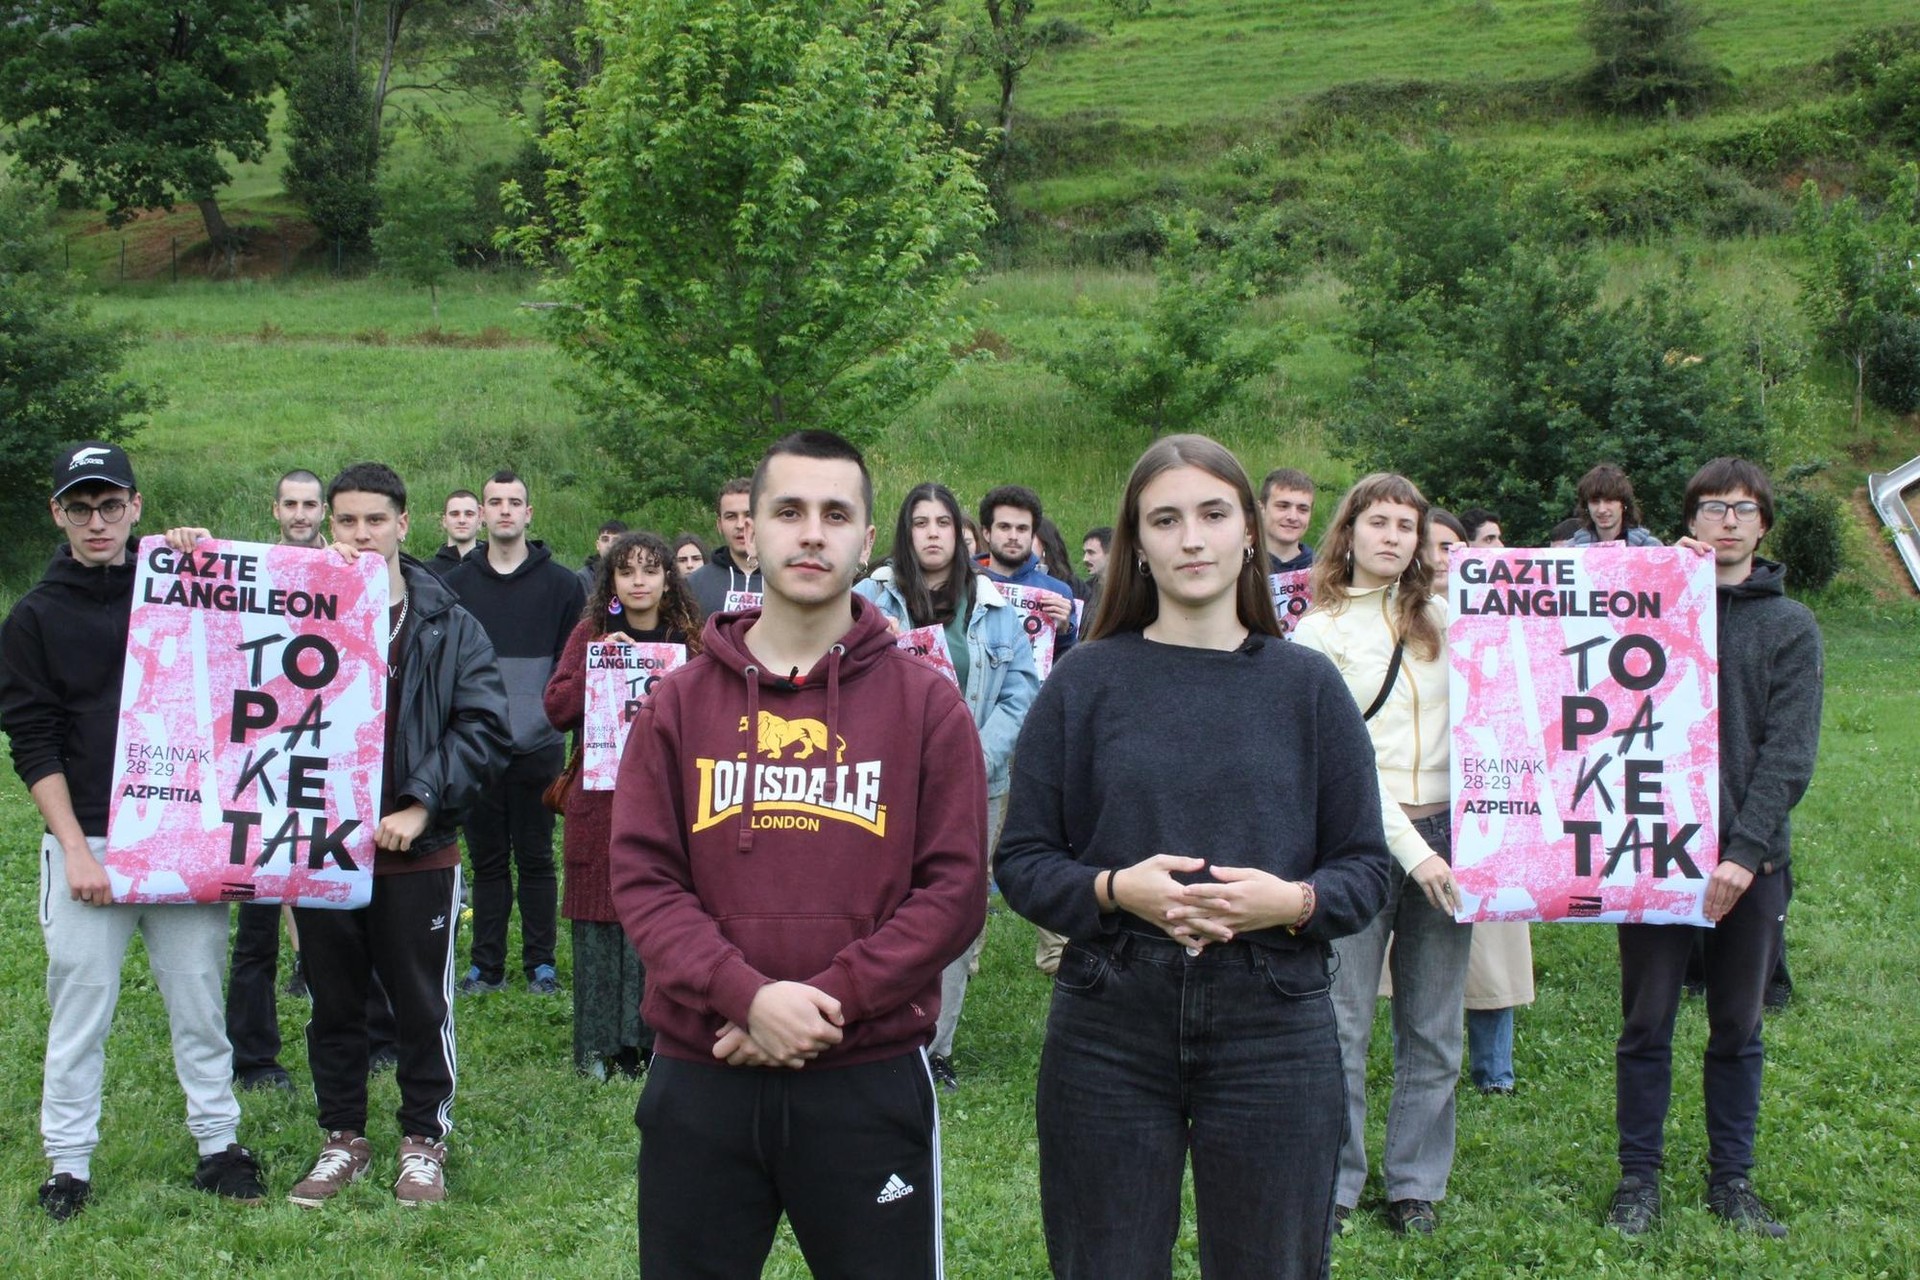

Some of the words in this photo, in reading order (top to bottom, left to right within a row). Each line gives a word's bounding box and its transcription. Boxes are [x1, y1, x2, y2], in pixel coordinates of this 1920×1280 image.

[149, 547, 257, 581] GAZTE
[1460, 558, 1575, 585] GAZTE
[144, 577, 337, 620] LANGILEON
[1460, 589, 1660, 620] LANGILEON
[235, 633, 339, 690] TO
[589, 658, 665, 670] LANGILEON
[590, 645, 632, 657] GAZTE
[1559, 633, 1667, 693] TO
[230, 689, 332, 752] PA
[1561, 695, 1664, 757] PA
[126, 760, 175, 777] 28-29
[127, 743, 211, 765] EKAINAK
[1464, 758, 1544, 774] EKAINAK
[233, 748, 328, 810] KE
[1463, 775, 1511, 790] 28-29
[1568, 752, 1664, 816] KE
[123, 785, 203, 804] AZPEITIA
[1463, 800, 1542, 816] AZPEITIA
[751, 815, 819, 832] LONDON
[222, 810, 362, 872] TAK
[1563, 817, 1704, 880] TAK
[877, 1185, 914, 1203] adidas
